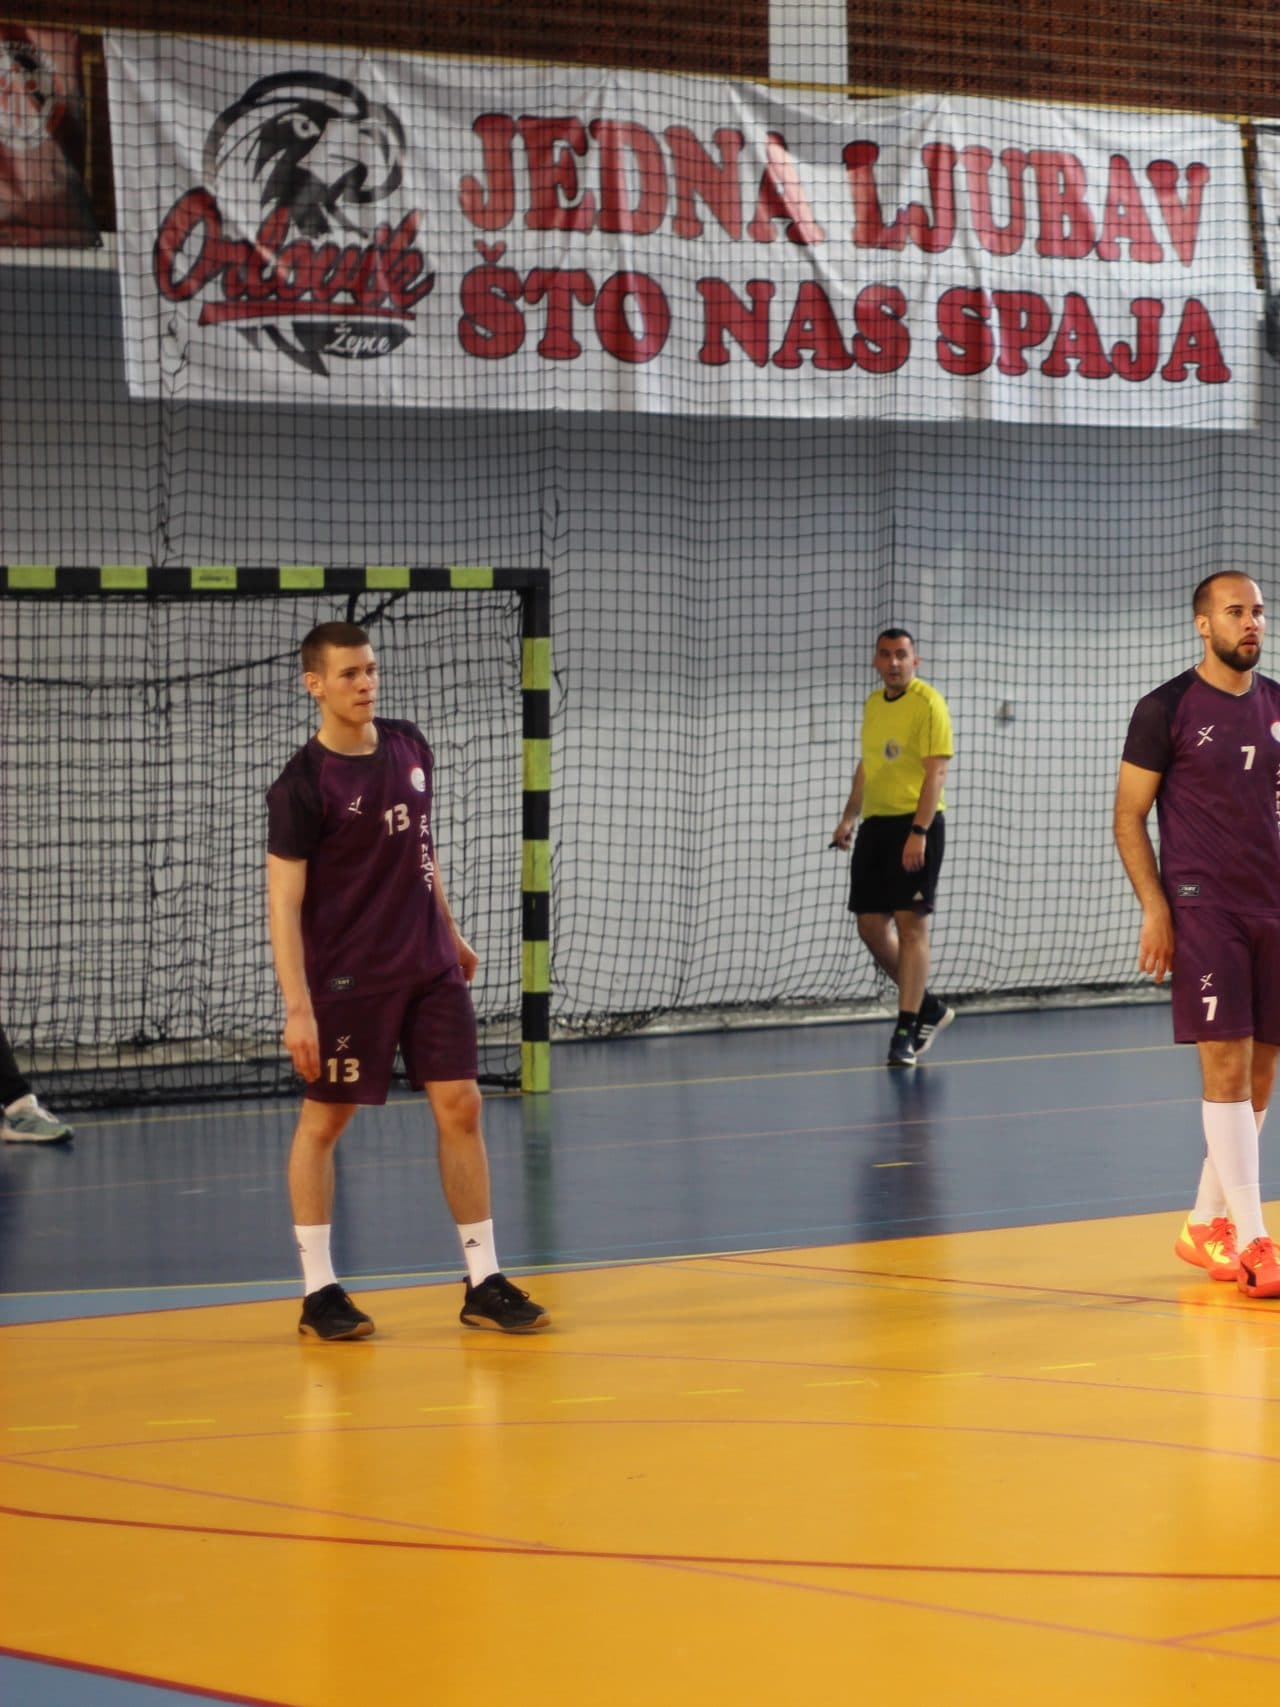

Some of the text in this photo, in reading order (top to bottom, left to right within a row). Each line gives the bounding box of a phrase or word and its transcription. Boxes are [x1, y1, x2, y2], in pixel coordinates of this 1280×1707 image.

[459, 112, 1211, 268] JEDNA LJUBAV
[457, 240, 1232, 384] ŠTO NAS SPAJA
[1240, 745, 1256, 770] 7
[383, 802, 411, 837] 13
[1201, 996, 1219, 1022] 7
[326, 1057, 361, 1083] 13
